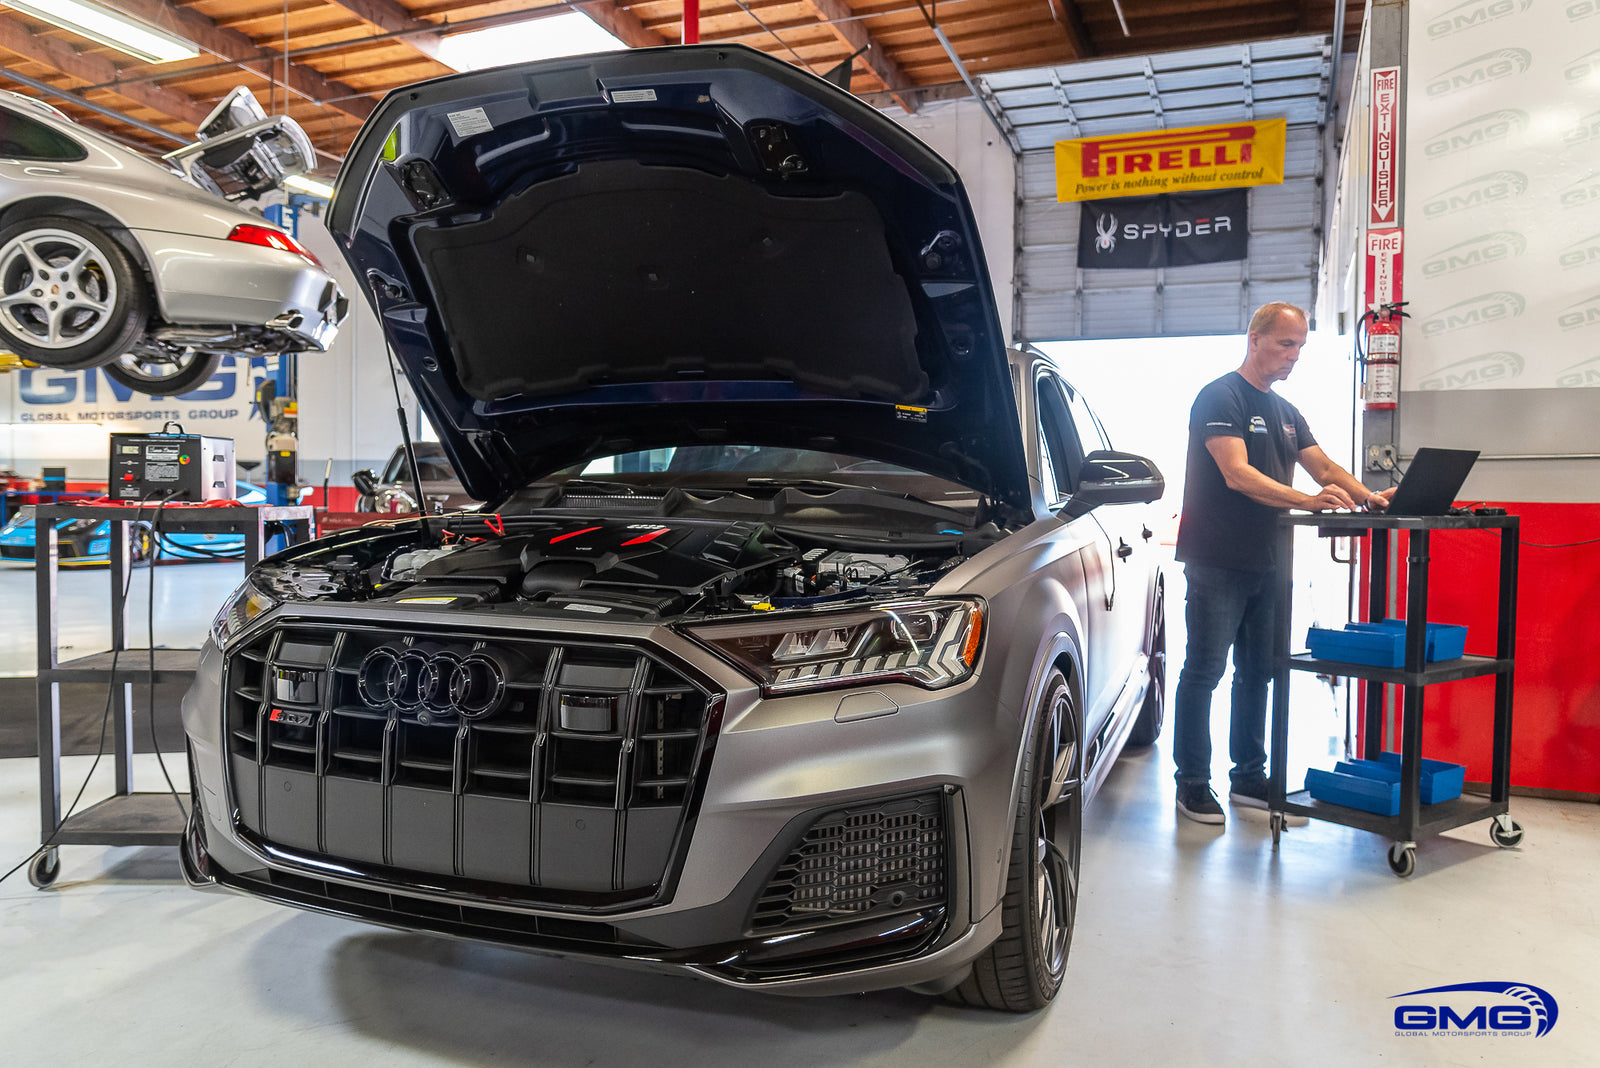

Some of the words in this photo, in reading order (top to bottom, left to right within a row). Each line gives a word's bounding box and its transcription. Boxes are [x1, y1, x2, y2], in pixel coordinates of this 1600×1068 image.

[1427, 0, 1514, 37] GMG
[1377, 78, 1394, 91] FIRE
[1426, 60, 1513, 97] GMG
[1081, 126, 1256, 178] PIRELLI
[1378, 93, 1390, 208] EXTINGUISHER
[1424, 121, 1511, 156] GMG
[1075, 183, 1108, 194] Power
[1111, 181, 1120, 190] is
[1123, 175, 1168, 188] nothing
[1172, 171, 1217, 185] without
[1220, 167, 1264, 181] control
[1423, 183, 1509, 216] GMG
[1123, 215, 1232, 240] SPYDER
[1371, 238, 1398, 251] FIRE
[1421, 243, 1510, 276] GMG
[1421, 303, 1509, 335] GMG
[1419, 363, 1507, 390] GMG
[21, 413, 70, 422] GLOBAL
[78, 410, 179, 420] MOTORSPORTS
[188, 409, 238, 419] GROUP
